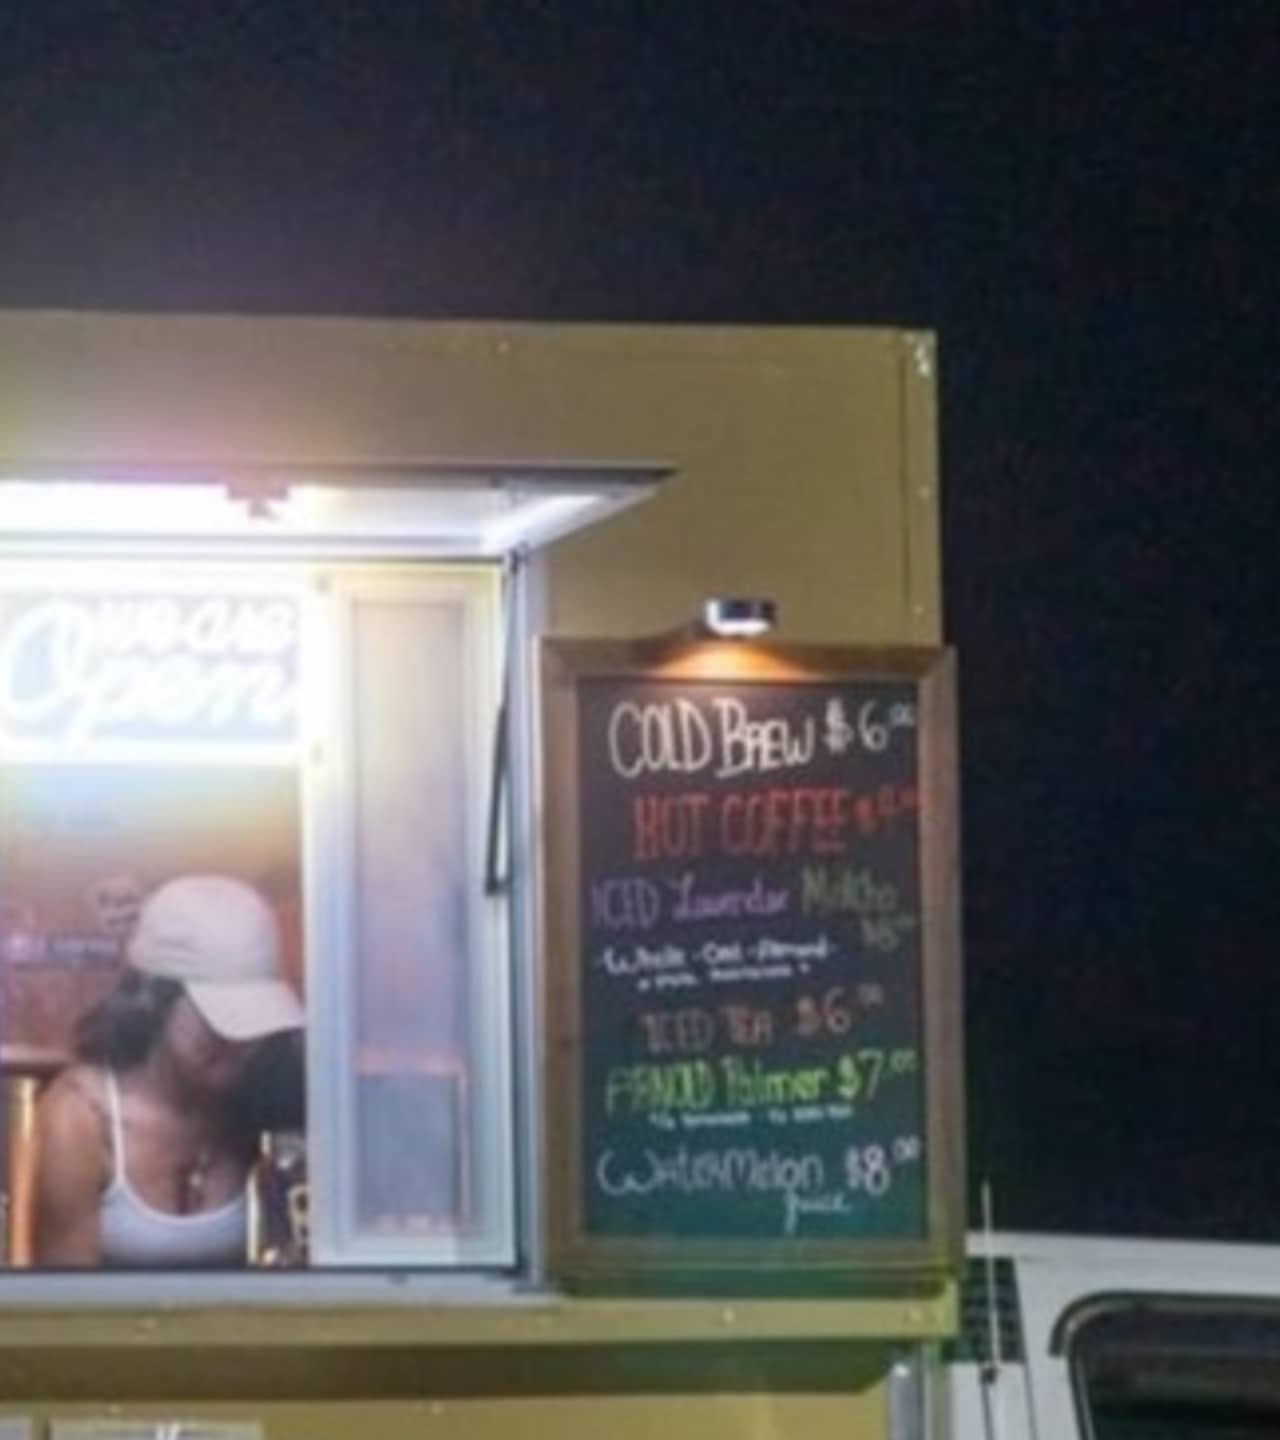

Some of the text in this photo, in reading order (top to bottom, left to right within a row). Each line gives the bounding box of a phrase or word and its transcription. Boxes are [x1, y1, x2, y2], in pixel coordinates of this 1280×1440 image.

[607, 698, 712, 779] COLD
[714, 697, 818, 779] BREW
[632, 790, 710, 862] HOT
[720, 786, 848, 860] COFFEE
